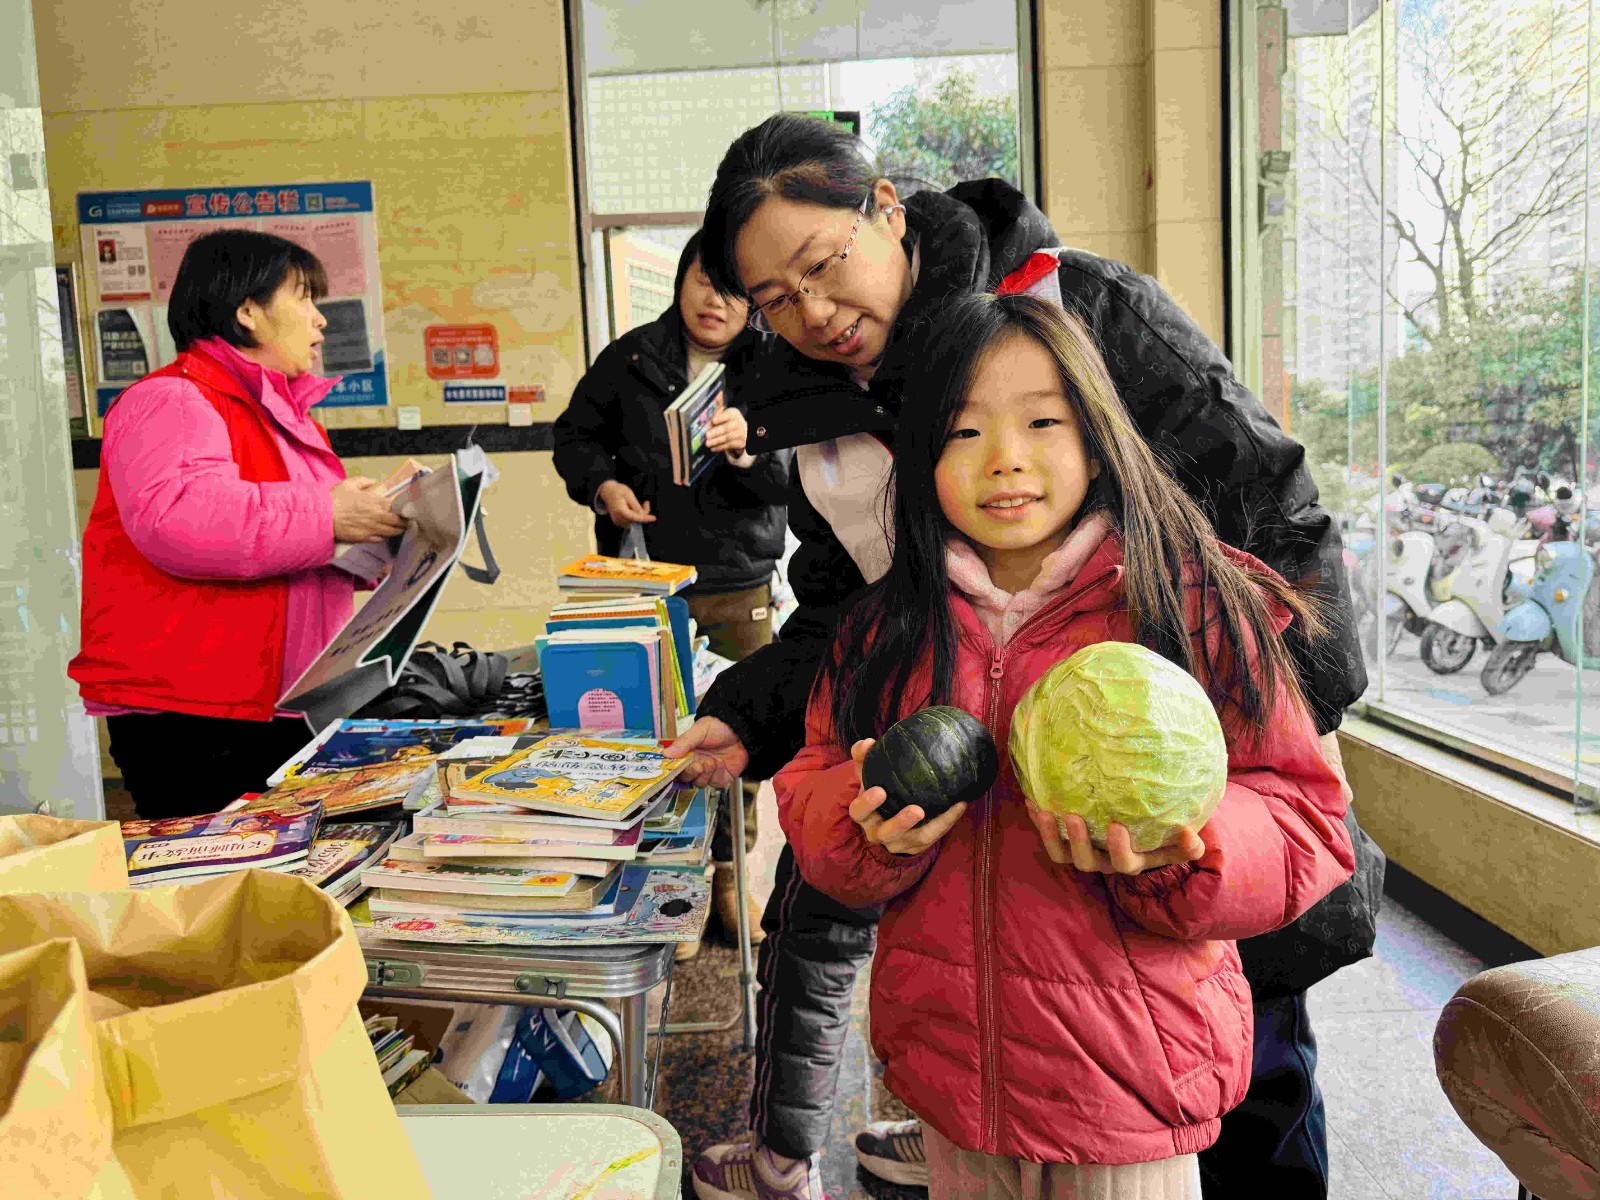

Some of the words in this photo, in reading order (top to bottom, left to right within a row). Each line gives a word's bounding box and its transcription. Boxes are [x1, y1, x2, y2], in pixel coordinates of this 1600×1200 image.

[185, 189, 300, 216] 宣传公告栏
